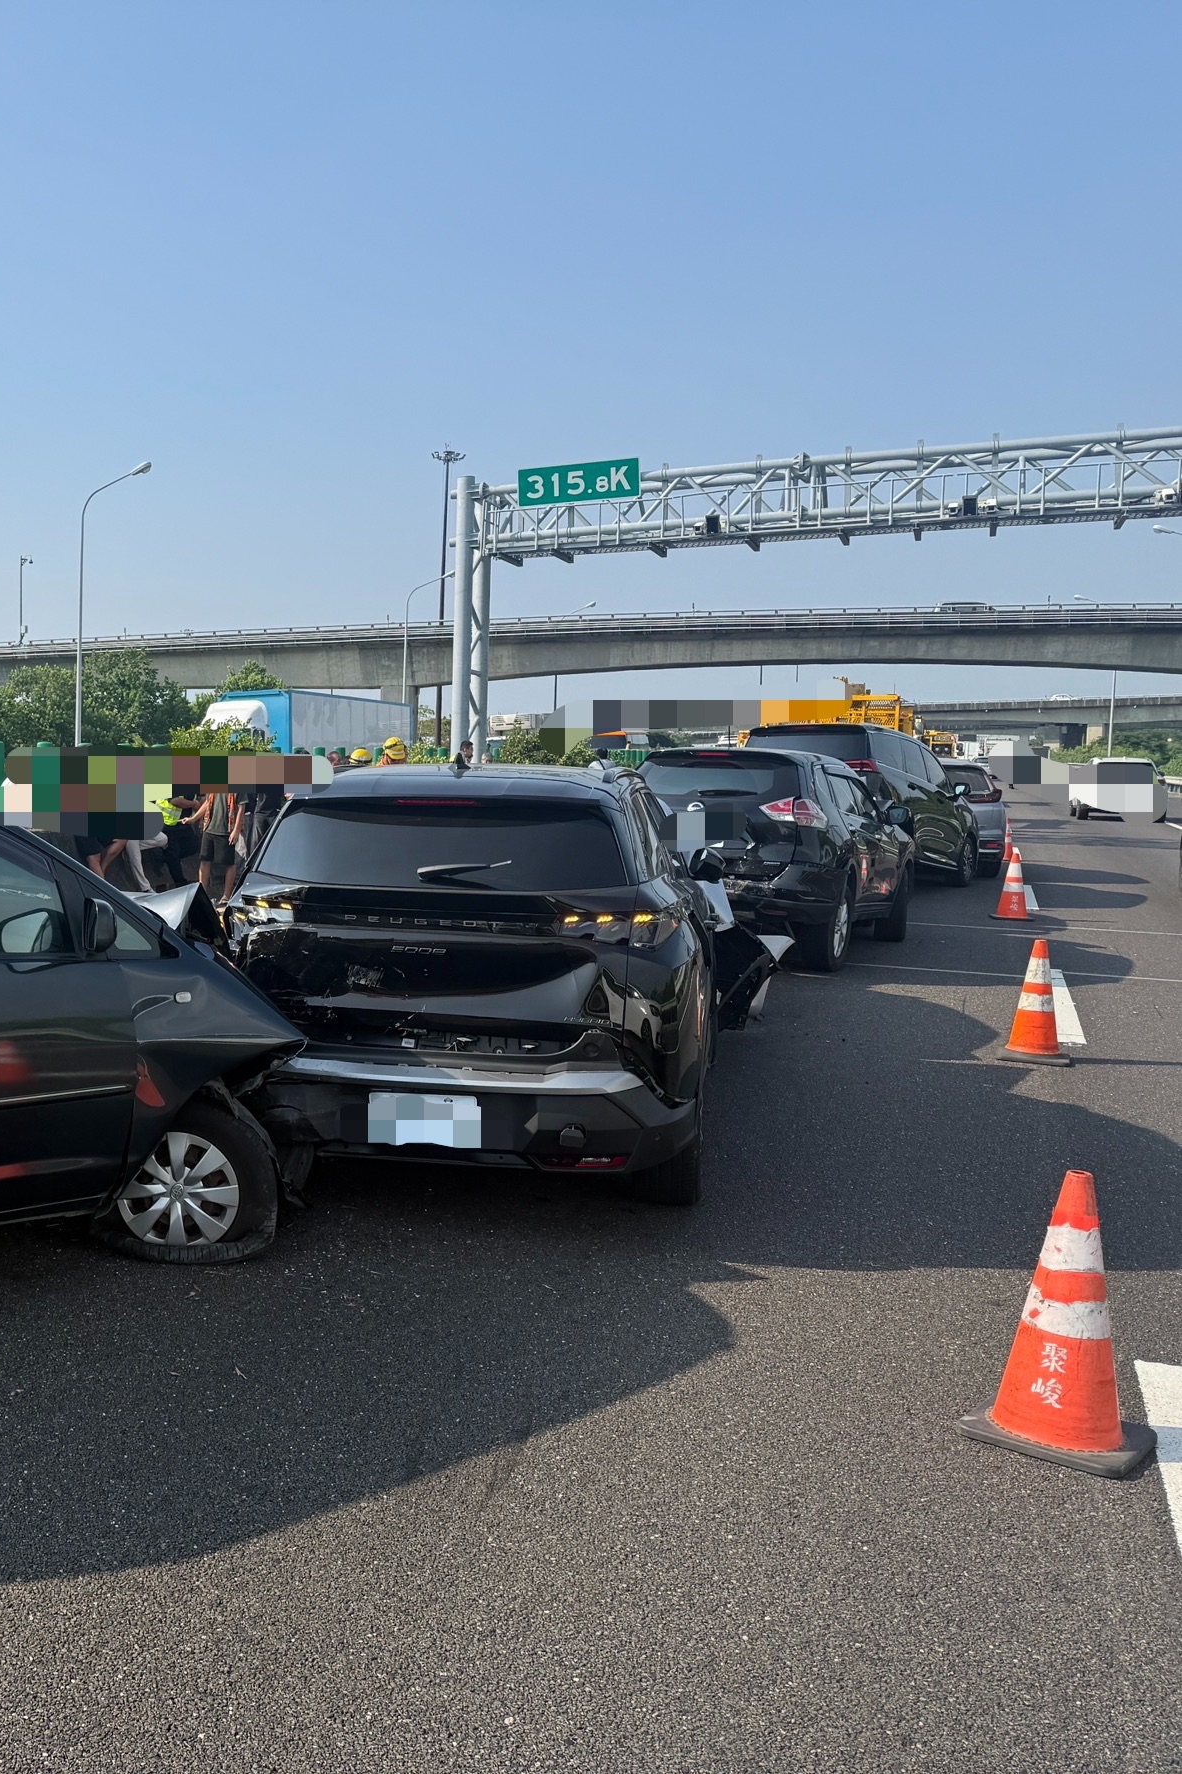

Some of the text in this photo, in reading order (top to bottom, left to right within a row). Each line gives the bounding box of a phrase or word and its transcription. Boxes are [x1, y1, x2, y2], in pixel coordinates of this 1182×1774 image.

[526, 465, 631, 499] 315.8K
[344, 914, 502, 931] PEUGEOT
[1030, 1342, 1068, 1409] 聚峻
